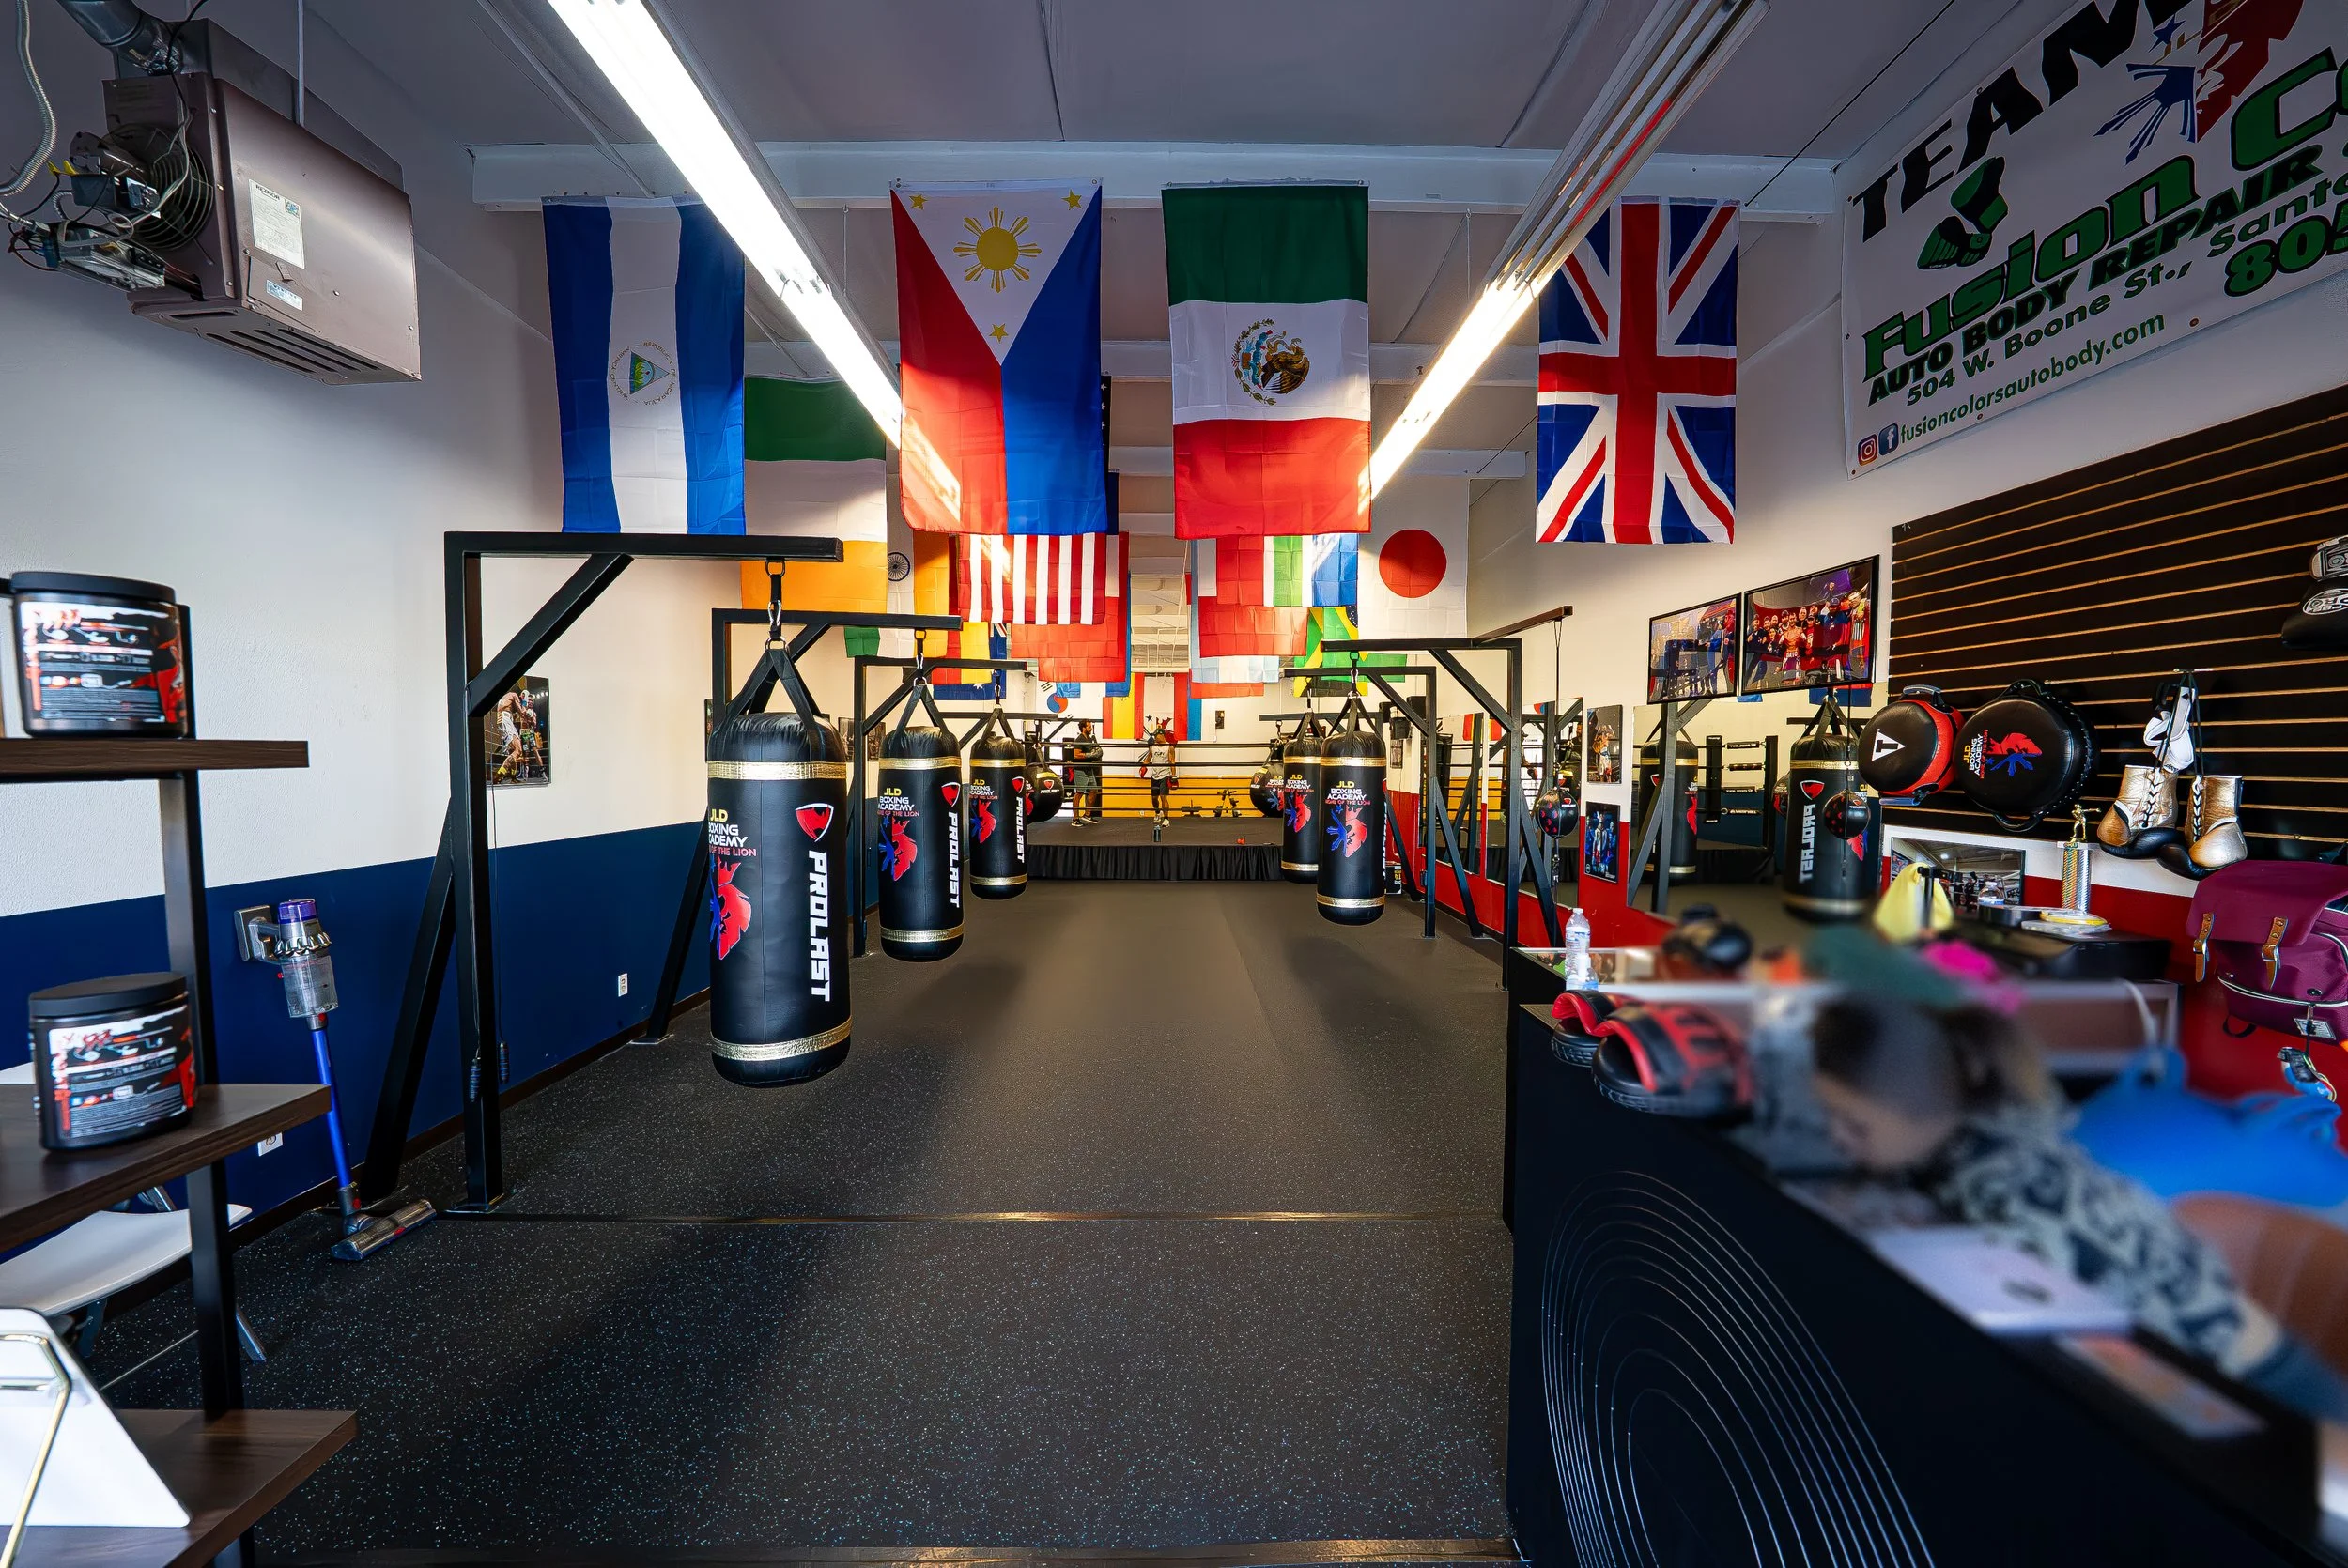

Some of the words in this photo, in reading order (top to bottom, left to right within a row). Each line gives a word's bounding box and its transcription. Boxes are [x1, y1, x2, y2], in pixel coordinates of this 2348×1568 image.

[1853, 0, 2194, 243] TEAM
[1862, 155, 2201, 383] Fusion
[2231, 46, 2348, 171] C
[1868, 342, 1953, 406] AUTO
[1962, 268, 2081, 357] BODY
[2088, 145, 2324, 291] REPAIR
[1900, 314, 2165, 444] fusioncolorsautobody.com
[1907, 368, 1955, 406] 504
[1962, 348, 1994, 378] W.
[2005, 294, 2111, 359] Boone
[884, 788, 902, 796] JLD
[1969, 738, 1977, 770] BOXING
[1974, 734, 1983, 776] ACADEMY
[710, 809, 728, 822] JLD
[880, 796, 909, 804] BOXING
[1016, 797, 1024, 863] PROLAST
[718, 847, 730, 856] THE
[733, 847, 757, 857] LION
[948, 812, 960, 908] PROLAST
[809, 850, 830, 1002] PROLAST
